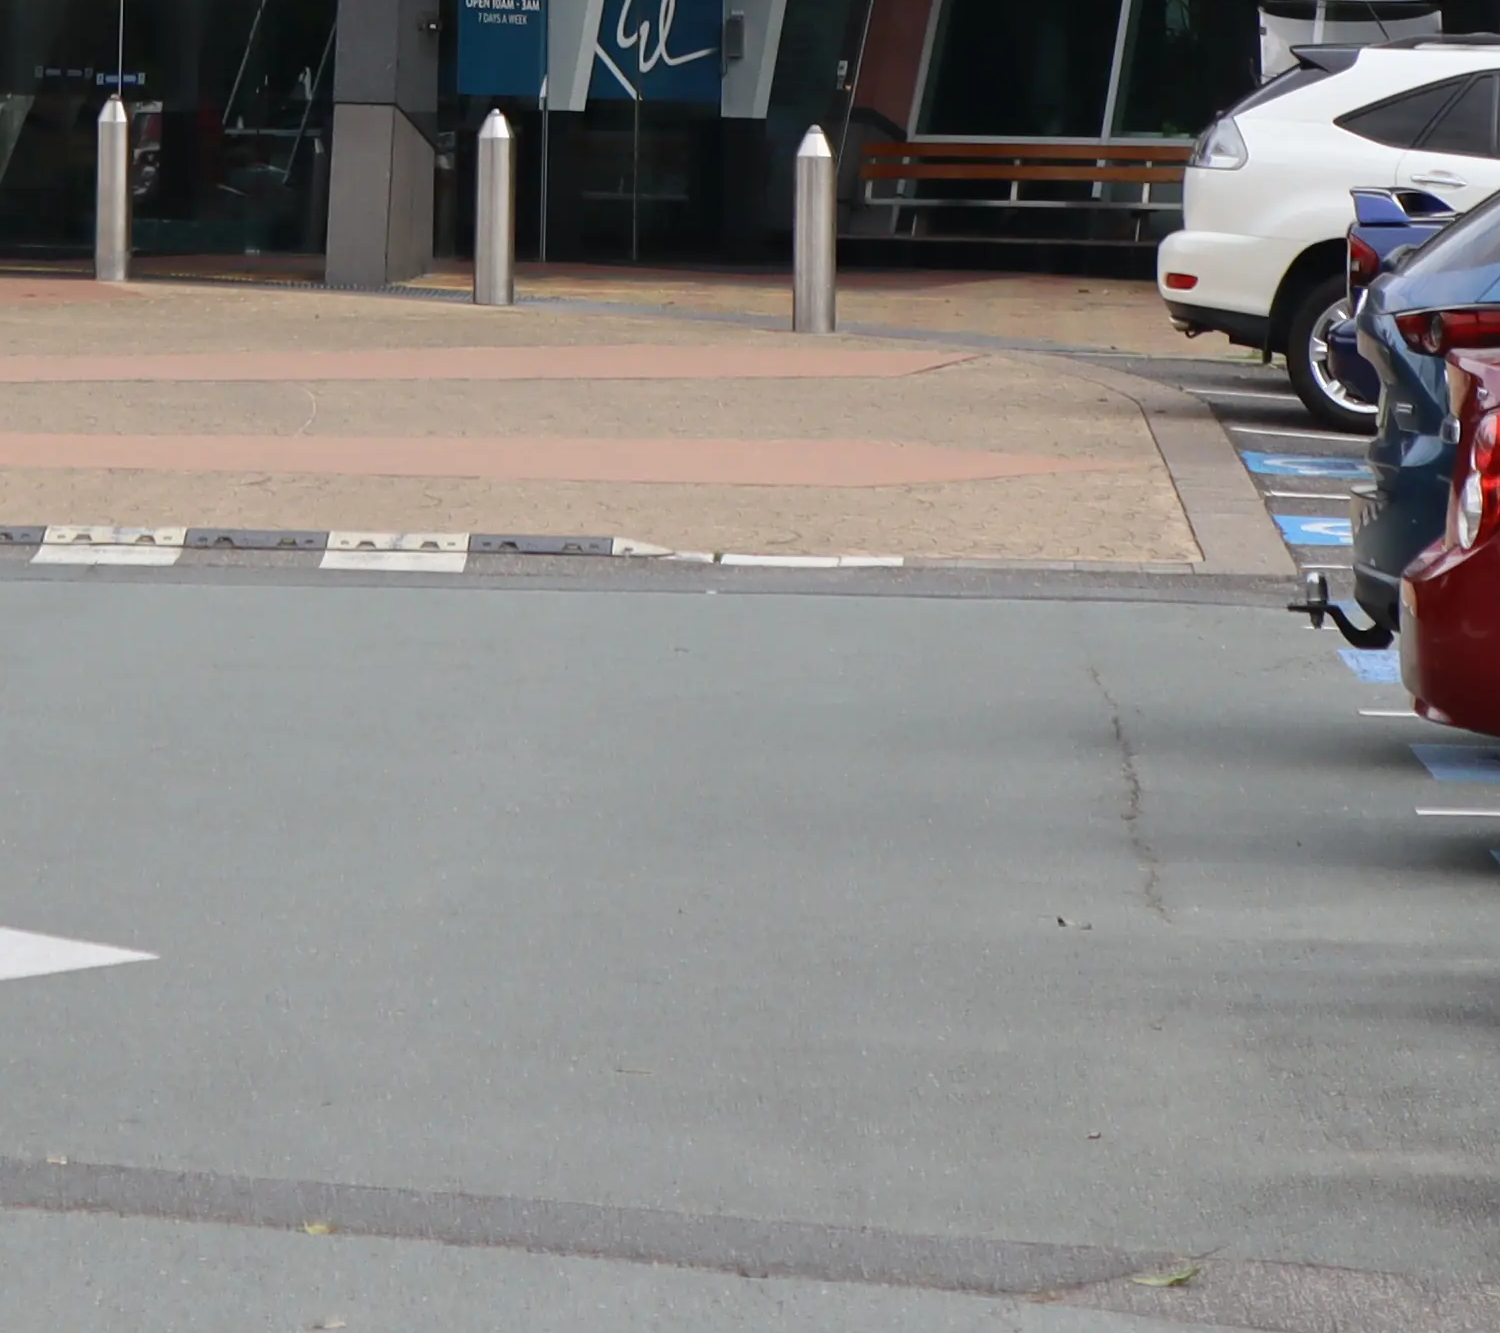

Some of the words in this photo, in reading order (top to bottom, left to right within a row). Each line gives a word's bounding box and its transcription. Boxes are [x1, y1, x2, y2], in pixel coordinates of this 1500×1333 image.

[483, 13, 501, 24] DAYS
[501, 14, 508, 24] A
[508, 14, 528, 25] WEEK
